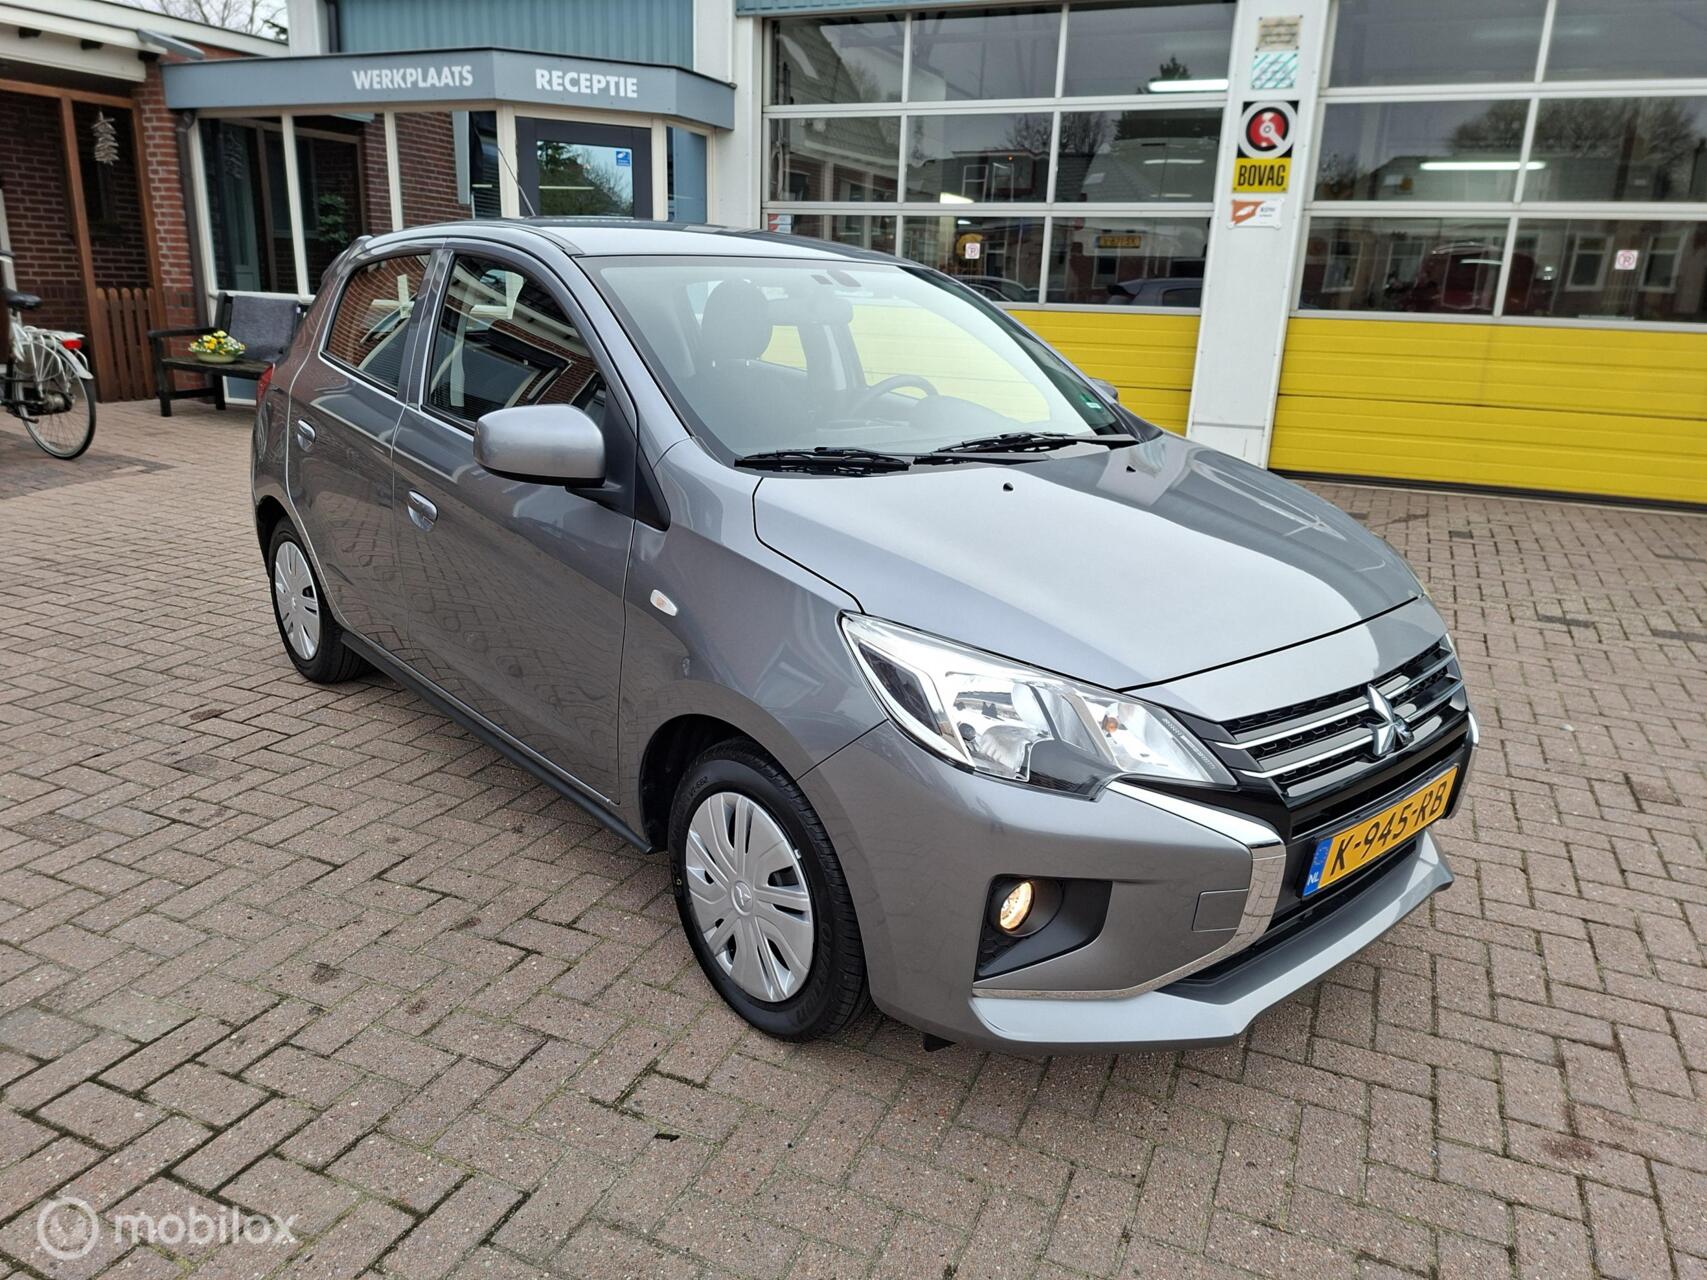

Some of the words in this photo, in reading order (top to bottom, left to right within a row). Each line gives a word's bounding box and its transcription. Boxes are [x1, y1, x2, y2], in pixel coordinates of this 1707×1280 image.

[352, 65, 473, 90] WERKPLAATS
[535, 68, 638, 98] RECEPTIE
[1237, 164, 1286, 187] BOVAG
[1330, 780, 1448, 877] K-945-RB
[1307, 871, 1320, 886] NL
